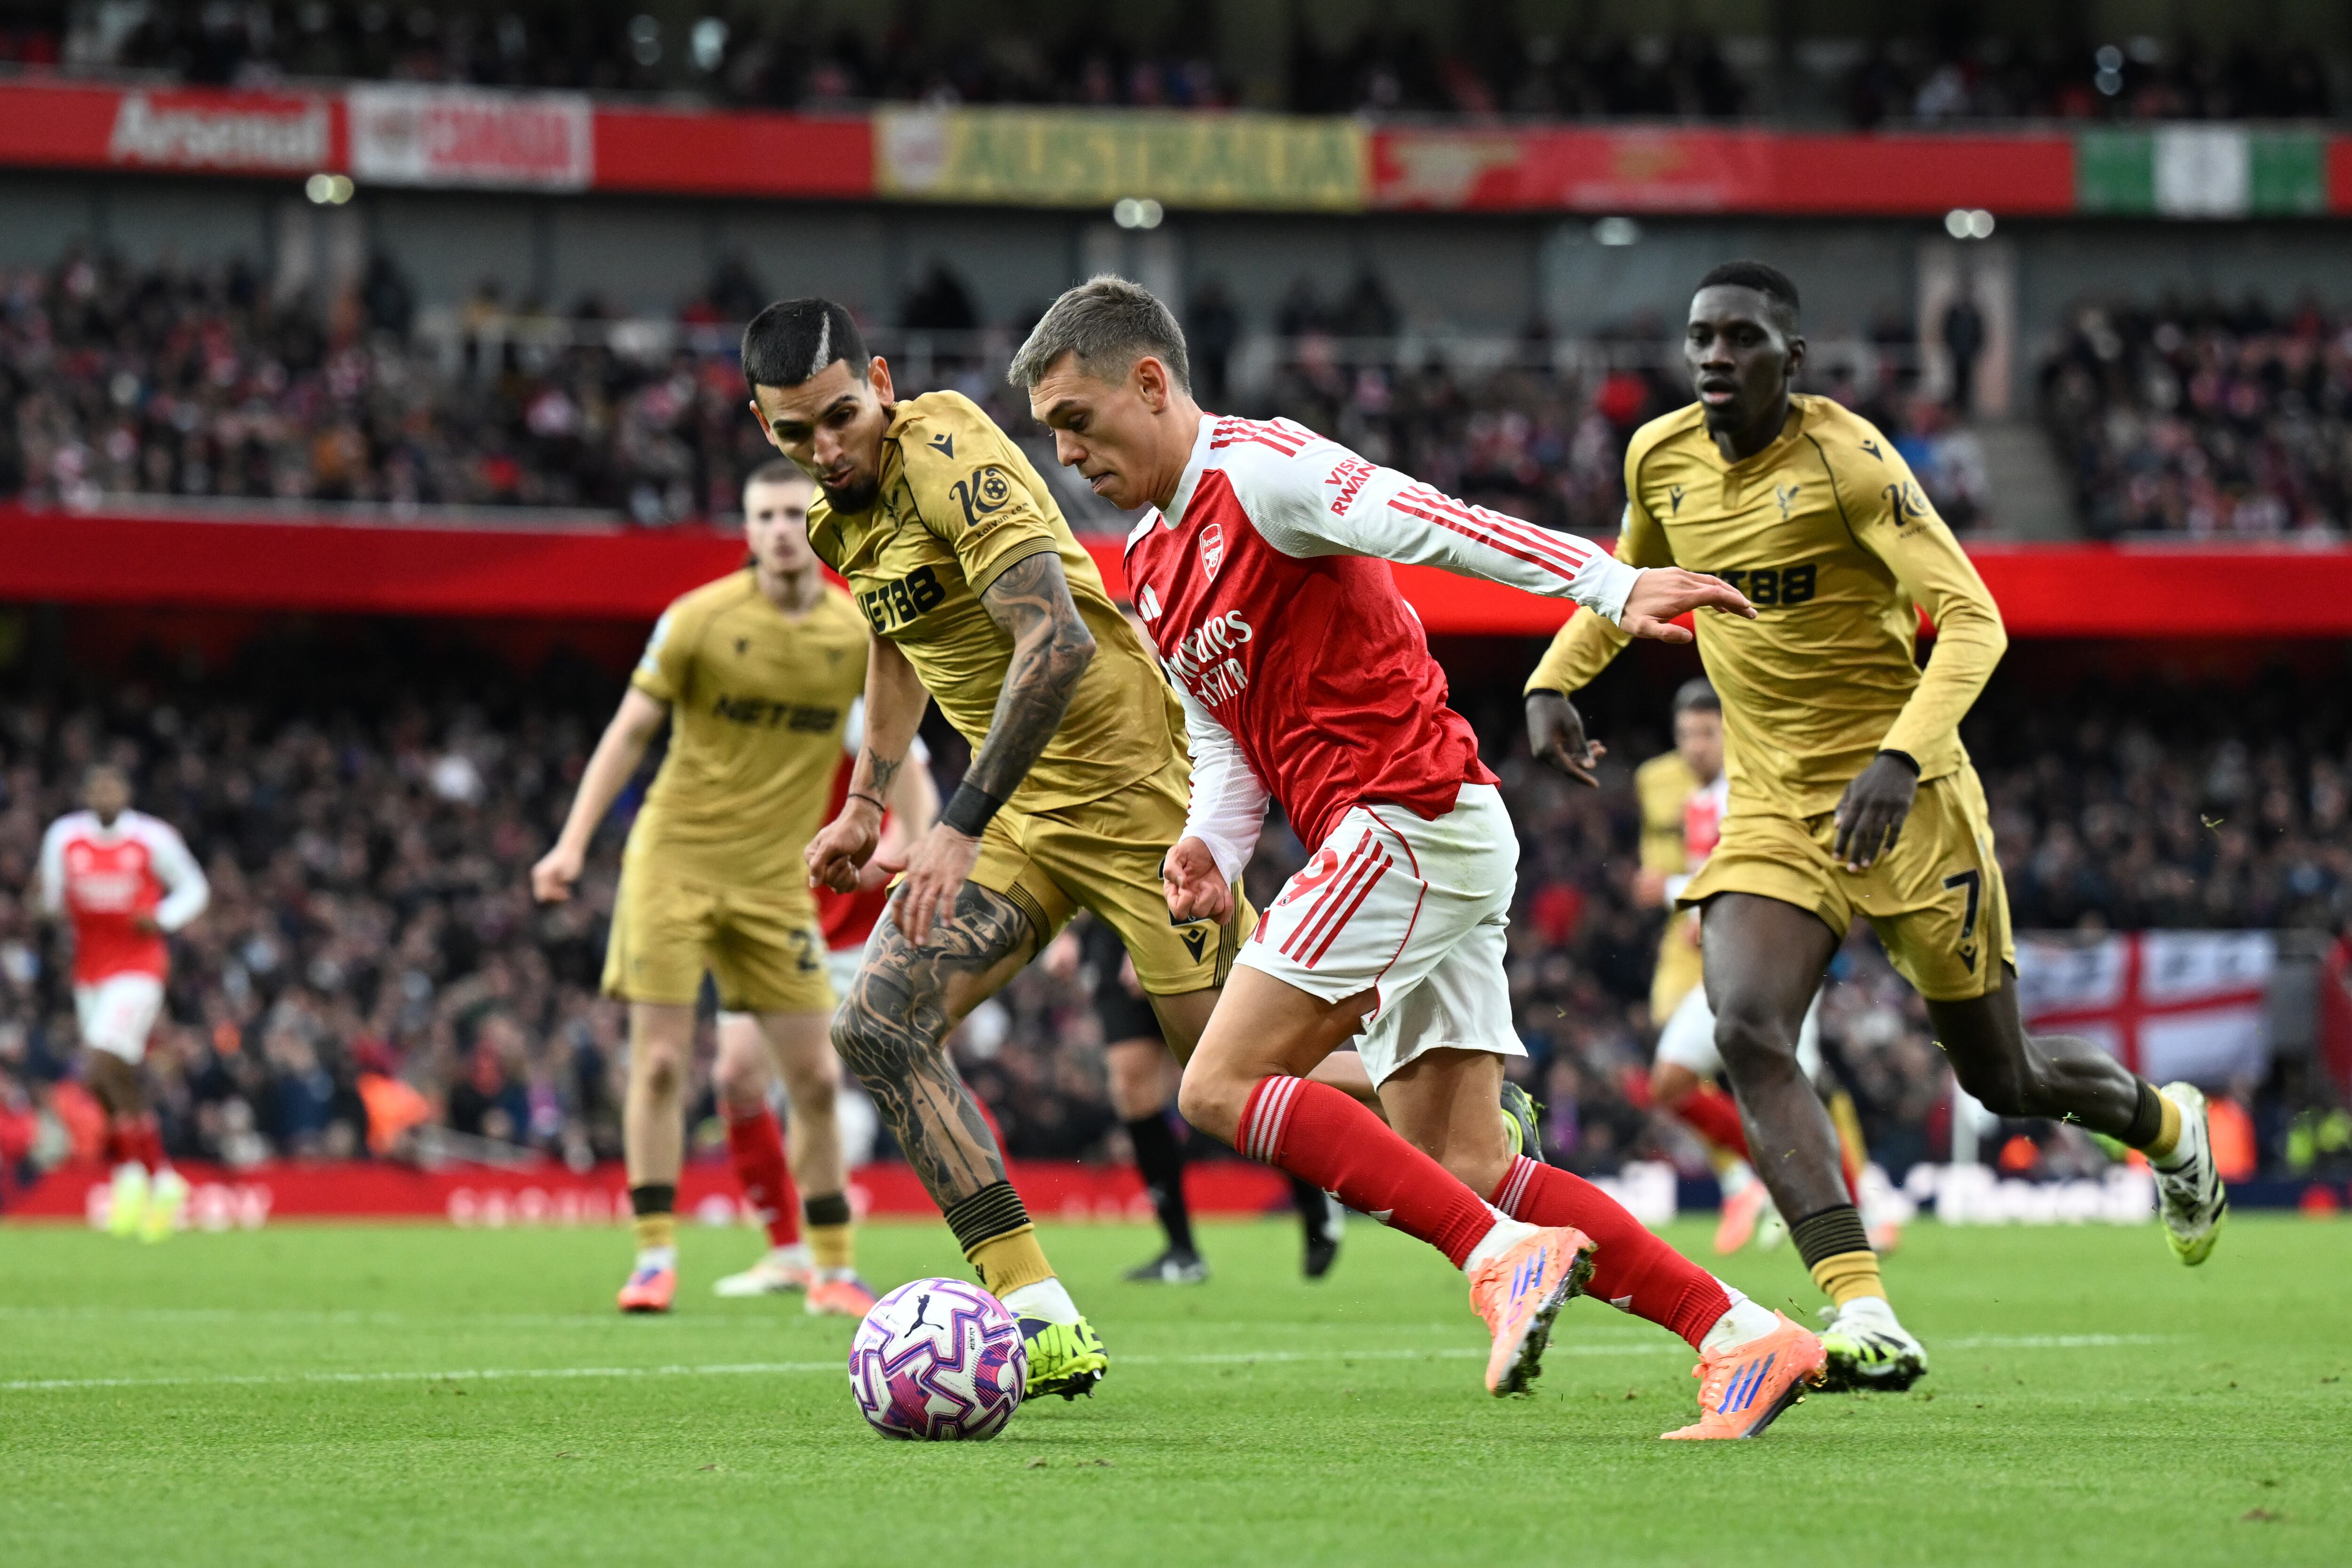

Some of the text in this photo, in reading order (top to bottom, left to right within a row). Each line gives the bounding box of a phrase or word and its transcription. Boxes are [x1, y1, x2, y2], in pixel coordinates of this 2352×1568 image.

[108, 91, 330, 166] Arsenal
[1330, 463, 1377, 517] RWAN
[1690, 562, 1817, 605] T88
[1166, 610, 1253, 685] mirates
[1943, 869, 1980, 939] 7
